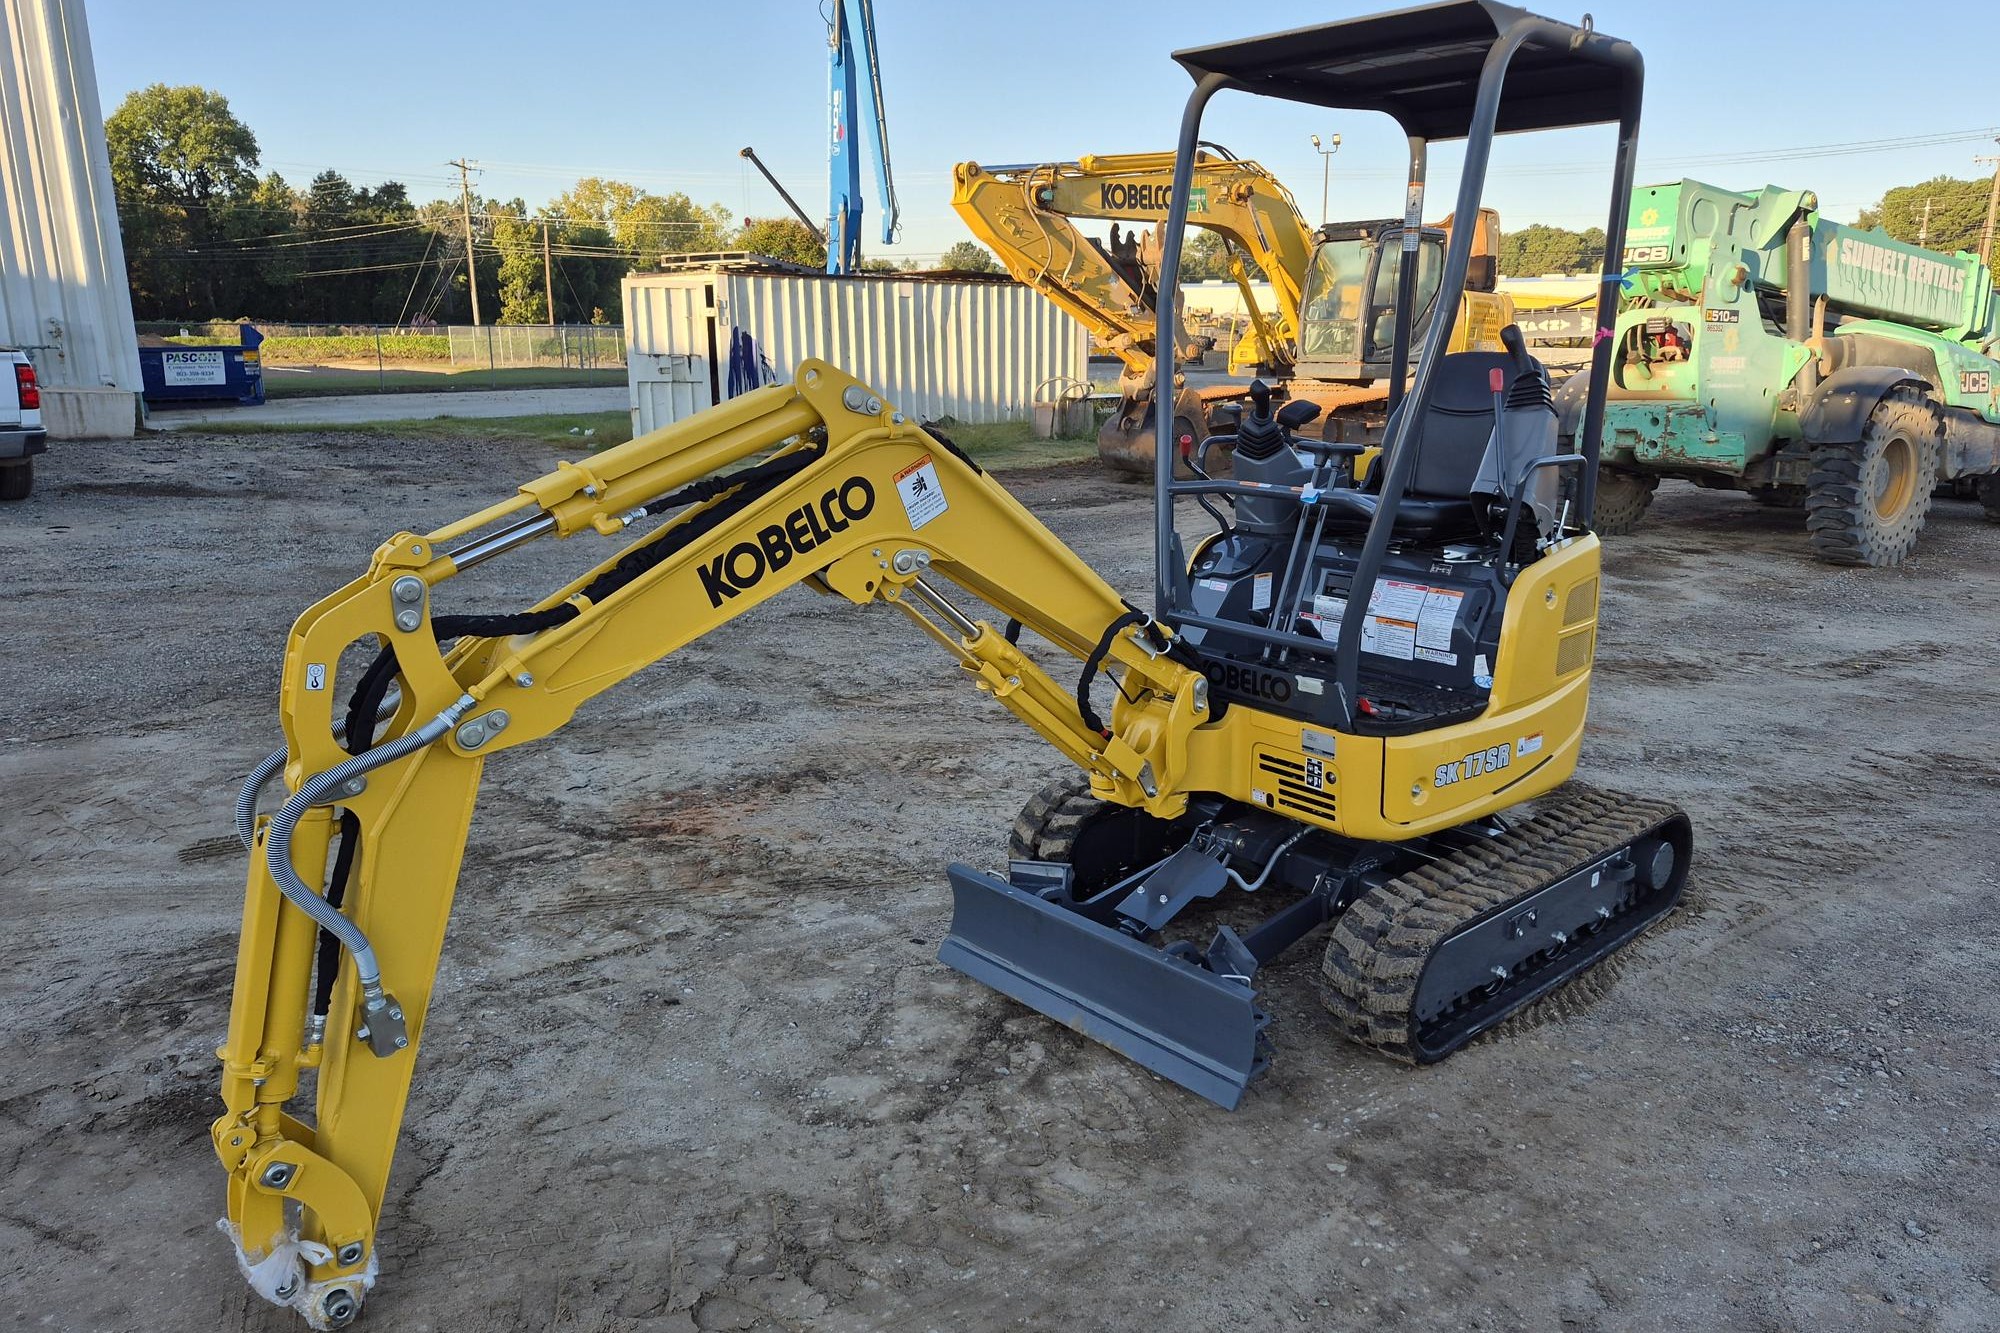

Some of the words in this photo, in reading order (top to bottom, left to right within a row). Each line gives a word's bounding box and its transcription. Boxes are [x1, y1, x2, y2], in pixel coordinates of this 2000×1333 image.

[1622, 247, 1668, 262] JCB
[1841, 237, 1907, 278] SUNBELT
[1906, 254, 1967, 293] RENTALS
[166, 353, 217, 363] PASCON
[1961, 371, 1989, 392] JCB
[697, 476, 876, 609] KOBELCO
[1425, 649, 1454, 659] WARNING
[1203, 660, 1291, 703] OBELCO
